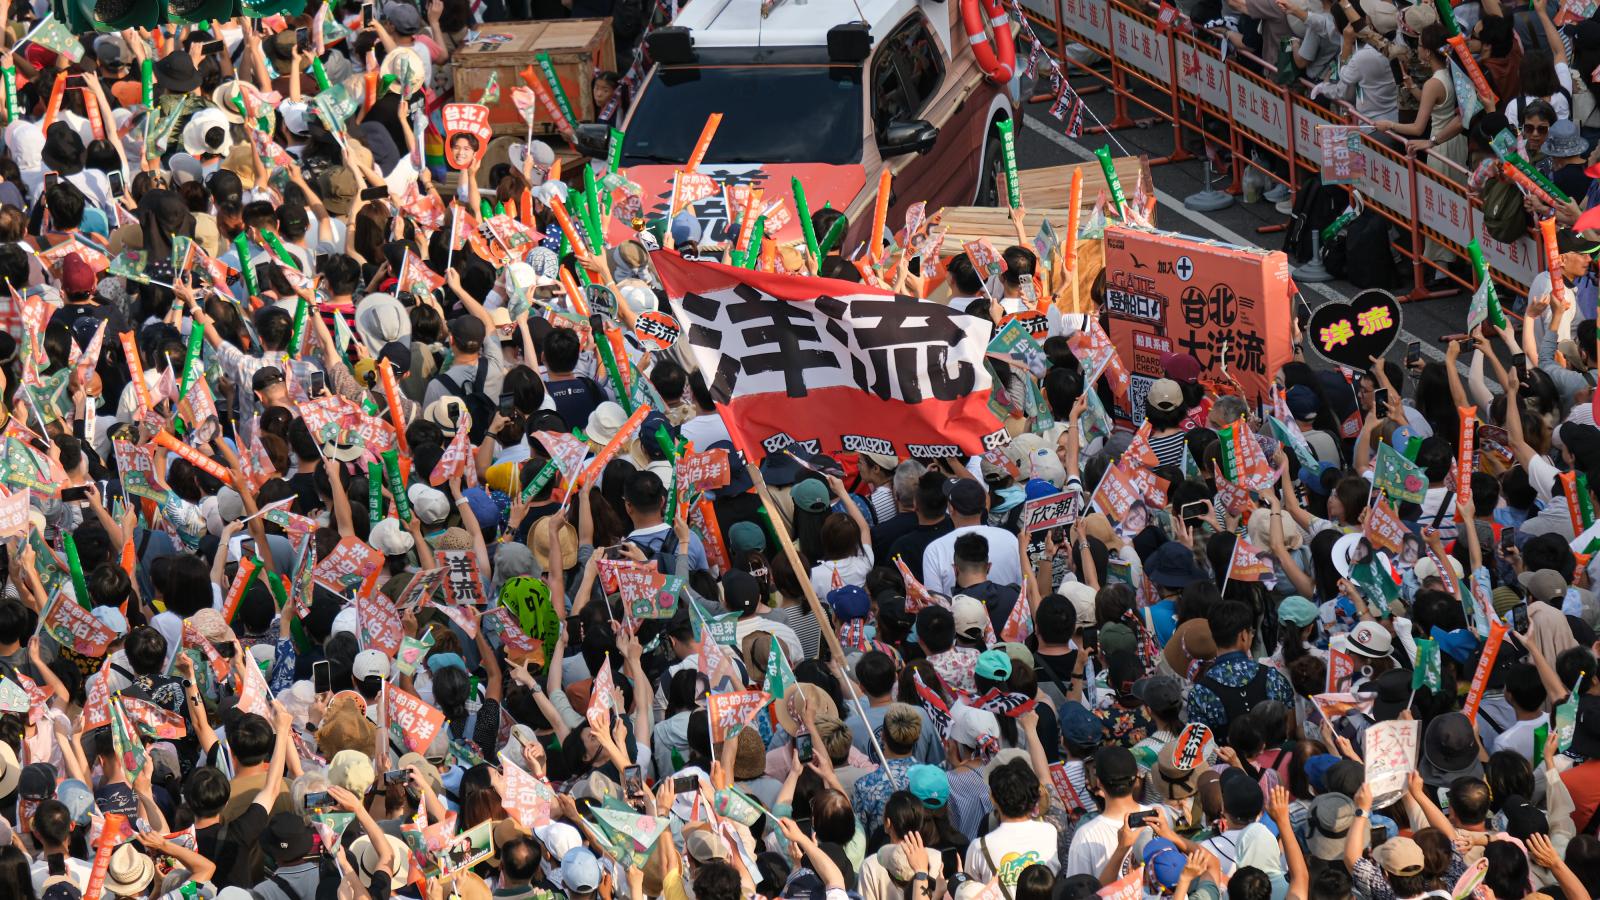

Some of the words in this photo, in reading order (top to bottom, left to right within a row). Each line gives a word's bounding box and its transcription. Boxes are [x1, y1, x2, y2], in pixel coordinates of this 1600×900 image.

[1117, 20, 1164, 67] 禁止進入
[1236, 83, 1283, 131] 禁止進入
[1360, 153, 1404, 201] 止進入
[1422, 185, 1469, 231] 禁止進入
[1112, 269, 1156, 293] GATE
[1157, 259, 1176, 275] 加入
[1109, 290, 1151, 317] 登船口
[1182, 286, 1237, 327] 台北
[636, 315, 680, 344] 洋流
[682, 282, 976, 405] 洋流
[1135, 334, 1171, 352] 船員系統
[1319, 304, 1394, 352] 洋流
[1178, 329, 1267, 376] 大洋流
[843, 435, 895, 456] 20261128
[908, 444, 963, 458] 20261128
[1461, 417, 1475, 495] 你的市長沈伯洋
[1029, 497, 1073, 526] 欣潮
[324, 543, 369, 584] 沈伯洋
[444, 555, 482, 601] 洋流
[54, 606, 109, 646] 沈伯洋
[62, 599, 103, 630] 你的市長
[710, 622, 734, 635] 起來
[388, 687, 431, 717] 你的市長
[716, 693, 761, 707] 你的市長
[388, 701, 435, 740] 沈伯洋
[1177, 724, 1207, 769] 洋流
